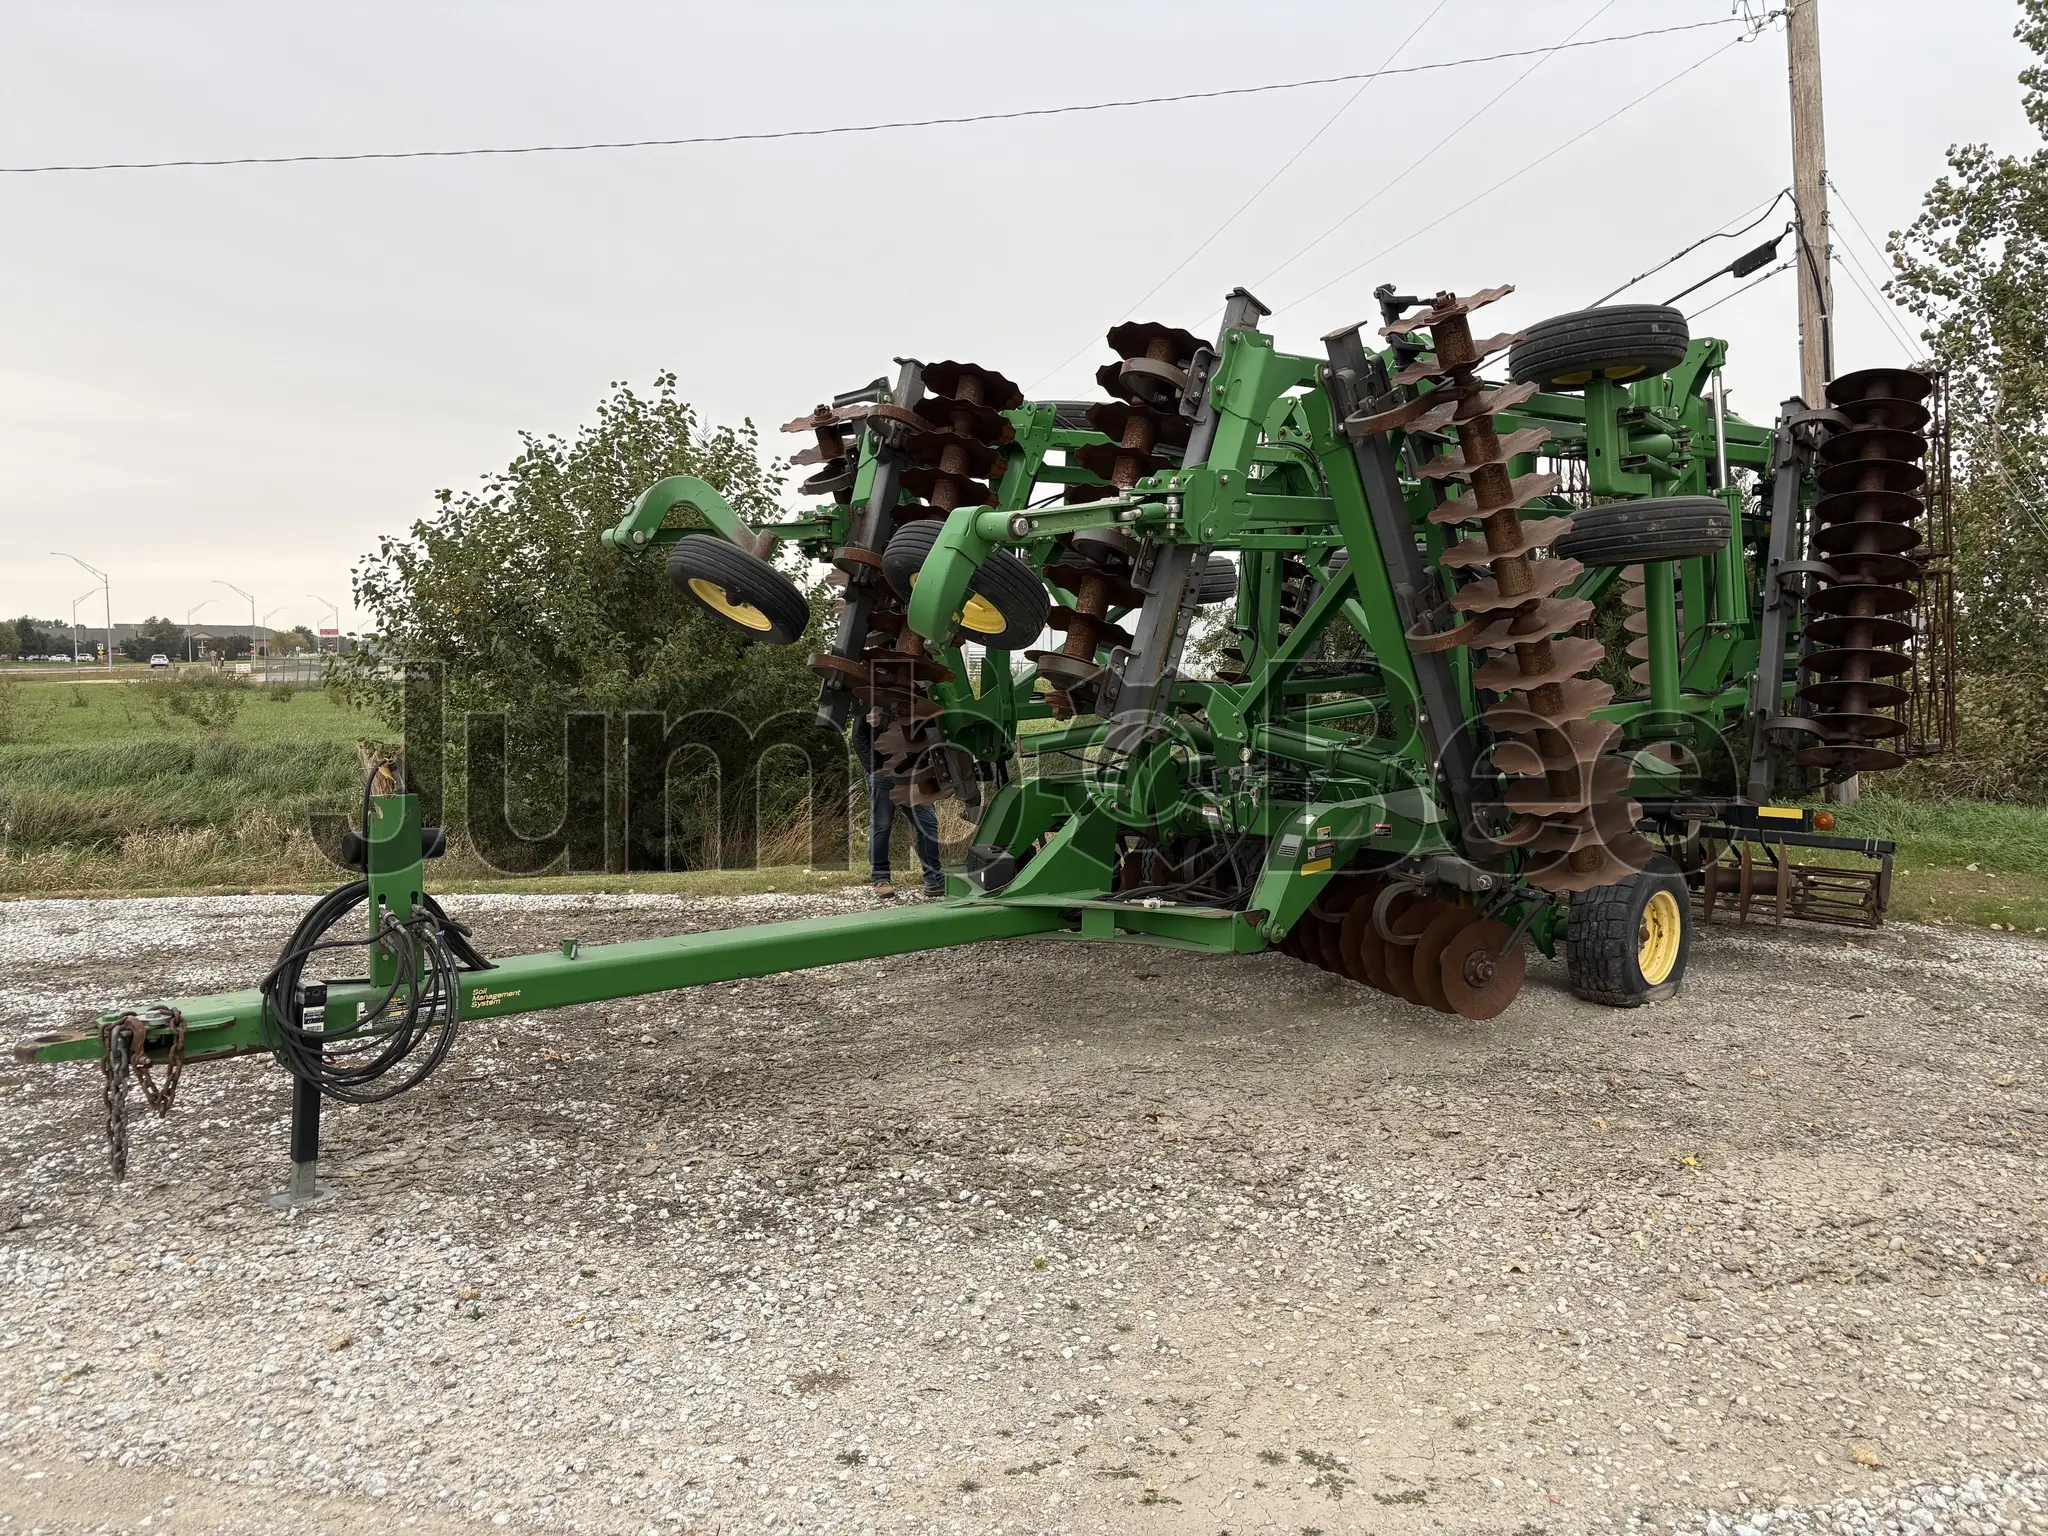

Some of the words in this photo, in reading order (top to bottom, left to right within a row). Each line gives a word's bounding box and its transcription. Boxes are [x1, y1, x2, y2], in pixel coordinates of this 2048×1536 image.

[471, 989, 521, 1002] Management
[472, 988, 488, 996] Soil
[471, 999, 501, 1009] System
